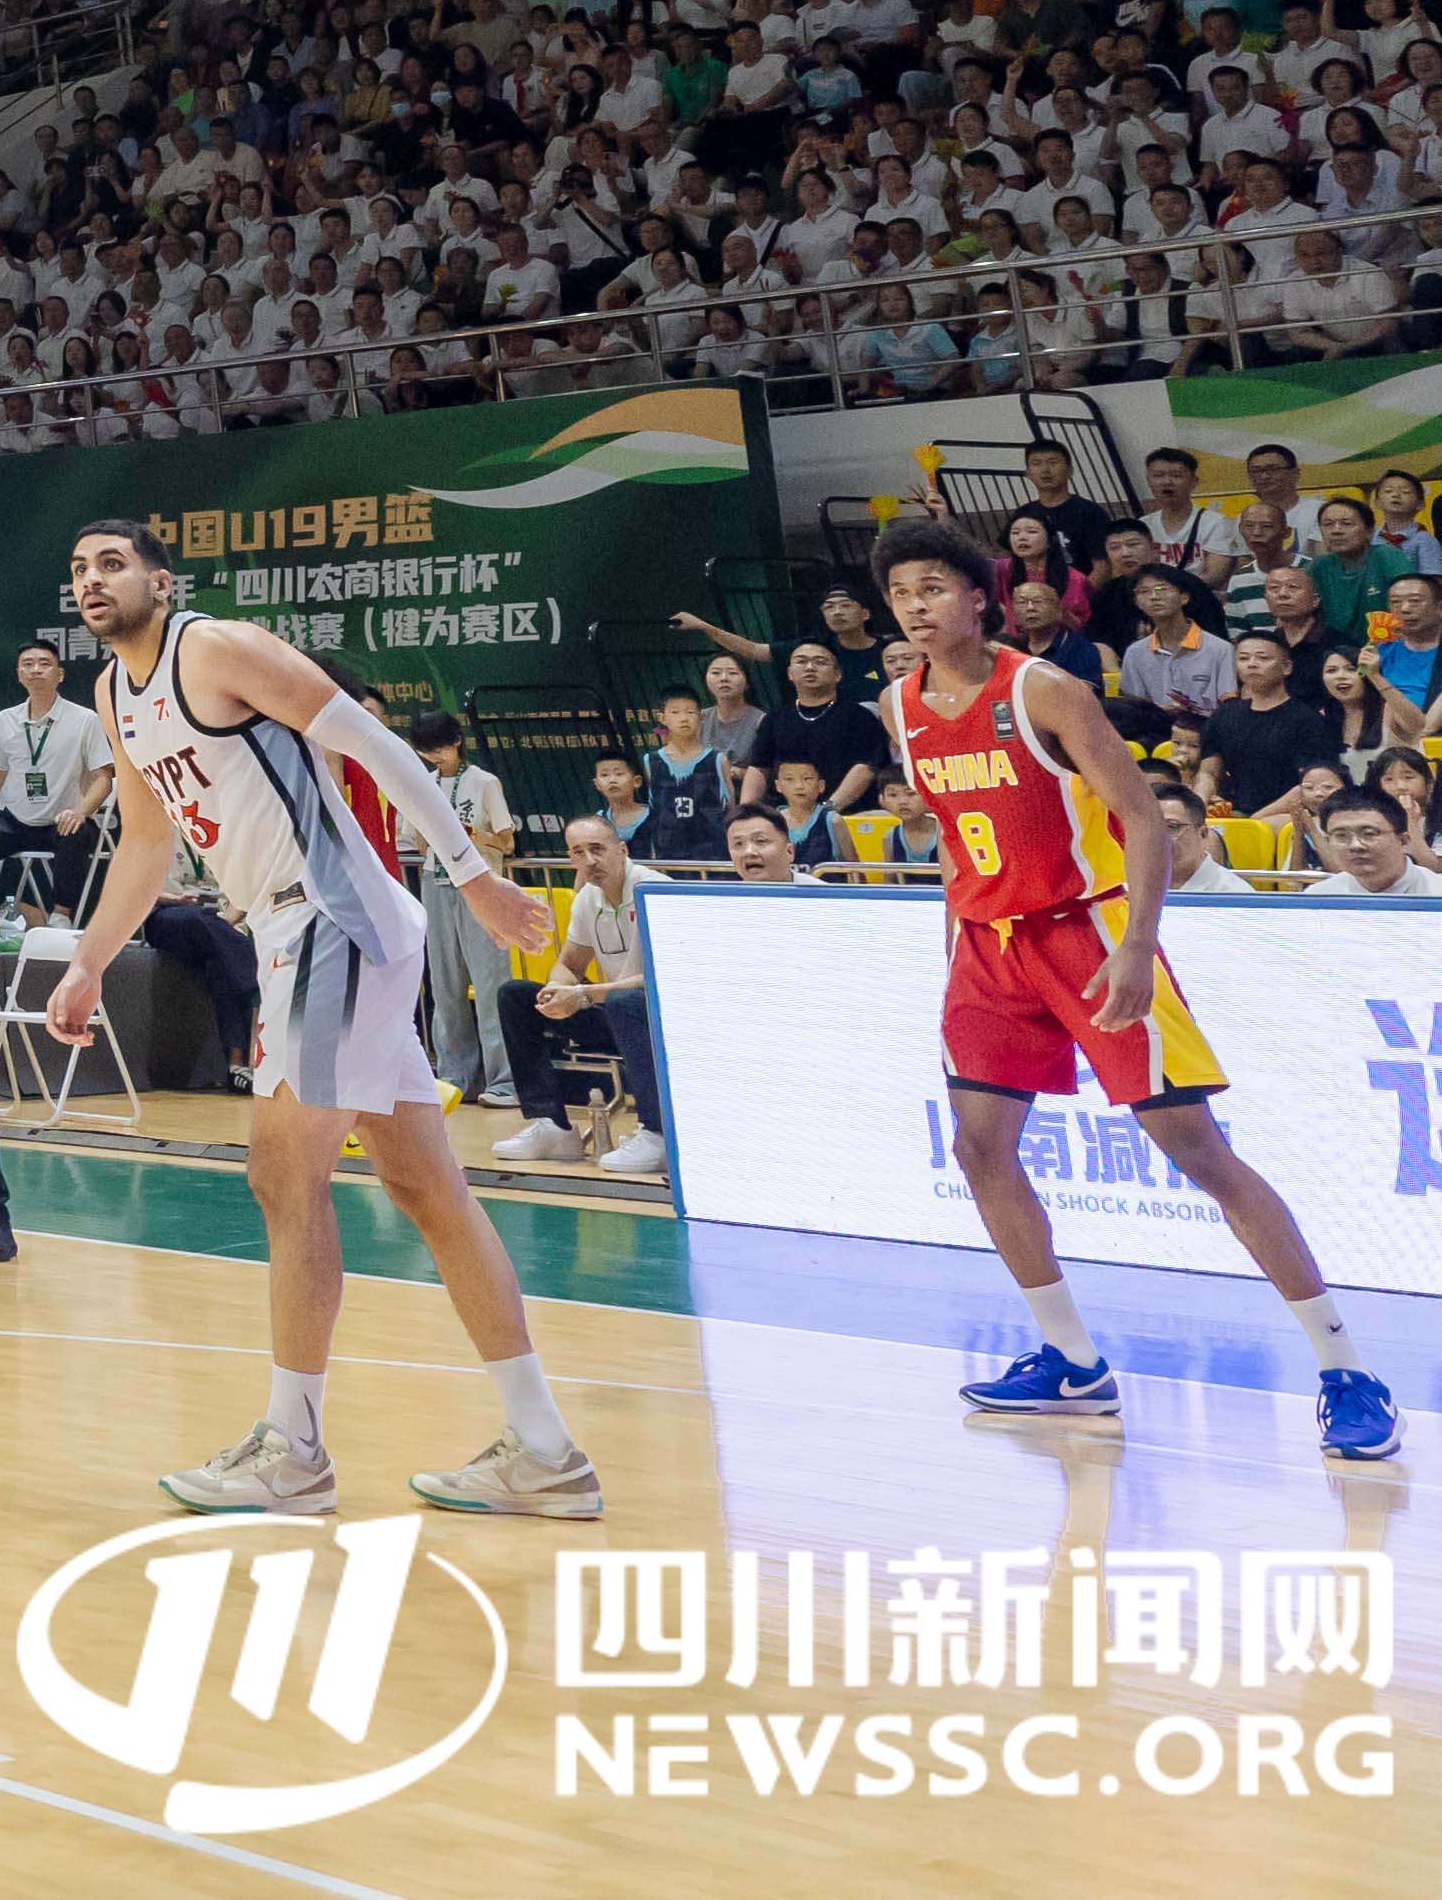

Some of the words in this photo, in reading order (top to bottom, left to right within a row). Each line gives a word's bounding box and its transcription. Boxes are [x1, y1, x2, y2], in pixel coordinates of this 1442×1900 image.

[917, 749, 1018, 794] CHINA
[955, 811, 1003, 877] 8
[1058, 1192, 1129, 1216] SHOCK
[1136, 1200, 1228, 1224] ABSORB
